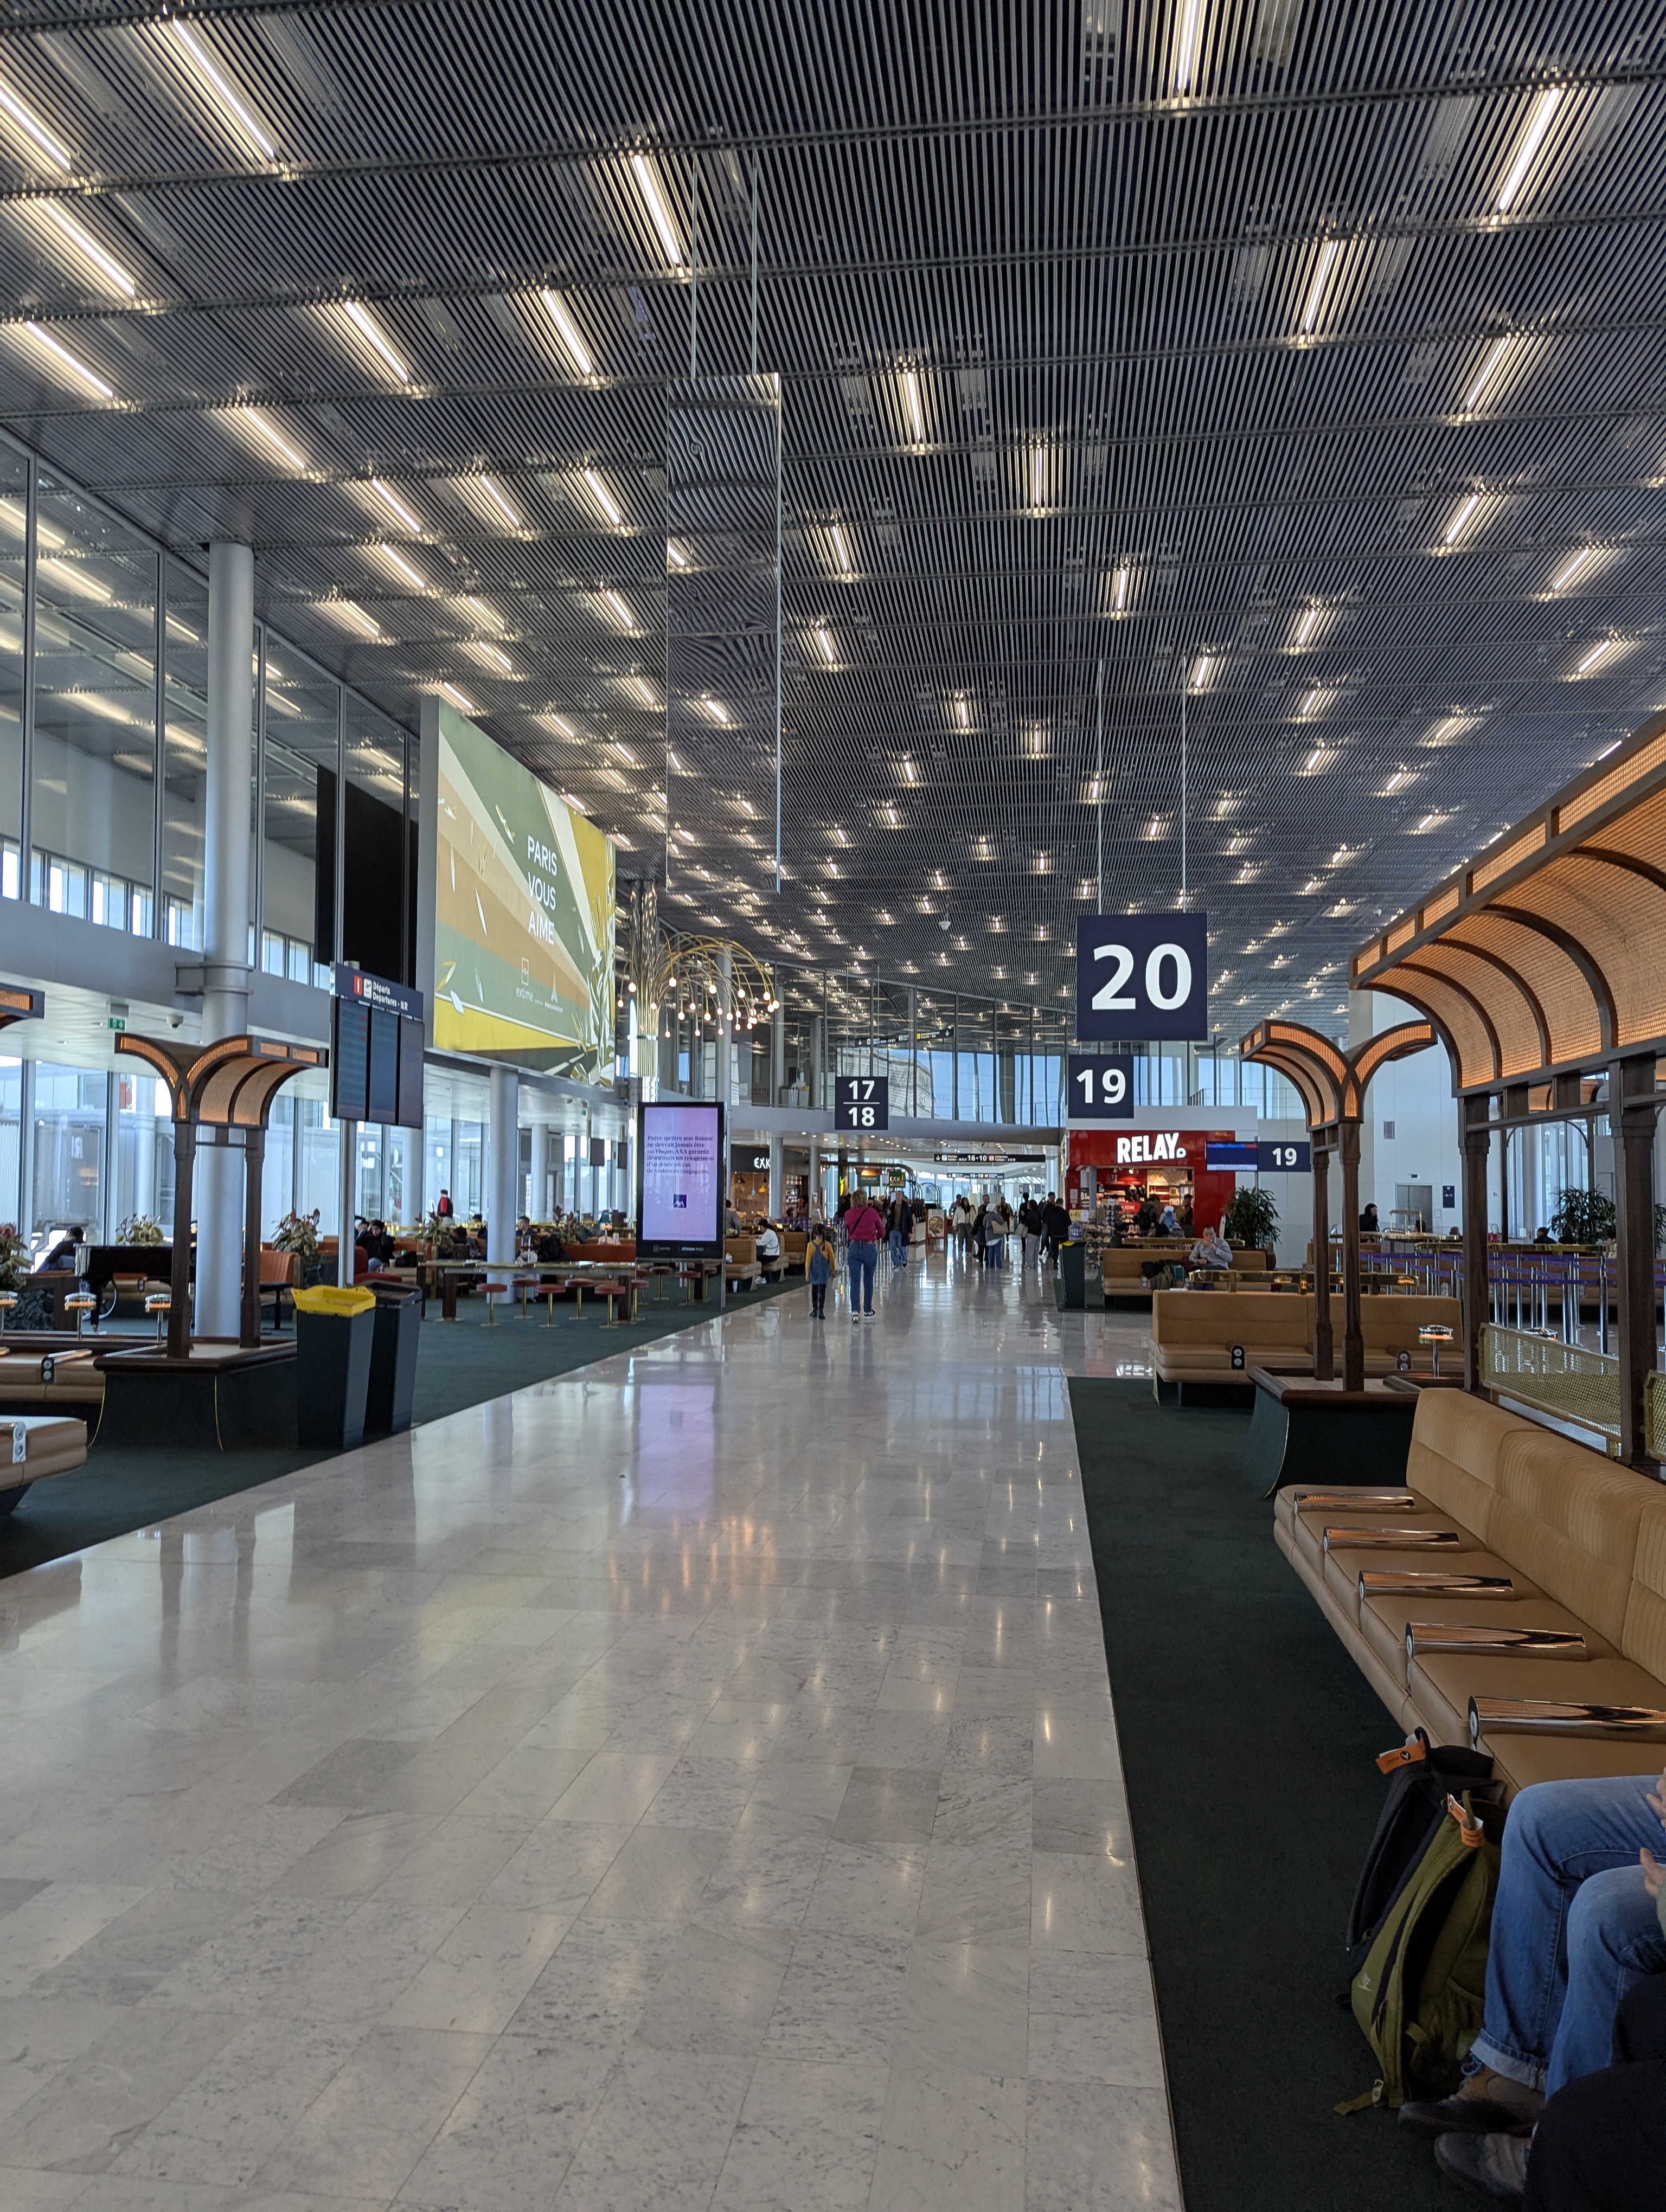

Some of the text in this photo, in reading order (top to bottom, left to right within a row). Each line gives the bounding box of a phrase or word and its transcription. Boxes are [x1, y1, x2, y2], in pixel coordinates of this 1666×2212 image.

[528, 834, 558, 877] PARIS
[528, 871, 556, 911] VOUS
[528, 910, 555, 946] AIME
[373, 981, 390, 995] Départs
[1092, 943, 1192, 1011] 20
[373, 991, 397, 1007] Departures
[848, 1080, 875, 1100] 17
[1077, 1069, 1126, 1104] 19
[848, 1107, 875, 1126] 18
[1117, 1132, 1179, 1163] RELAY
[1272, 1147, 1297, 1166] 19
